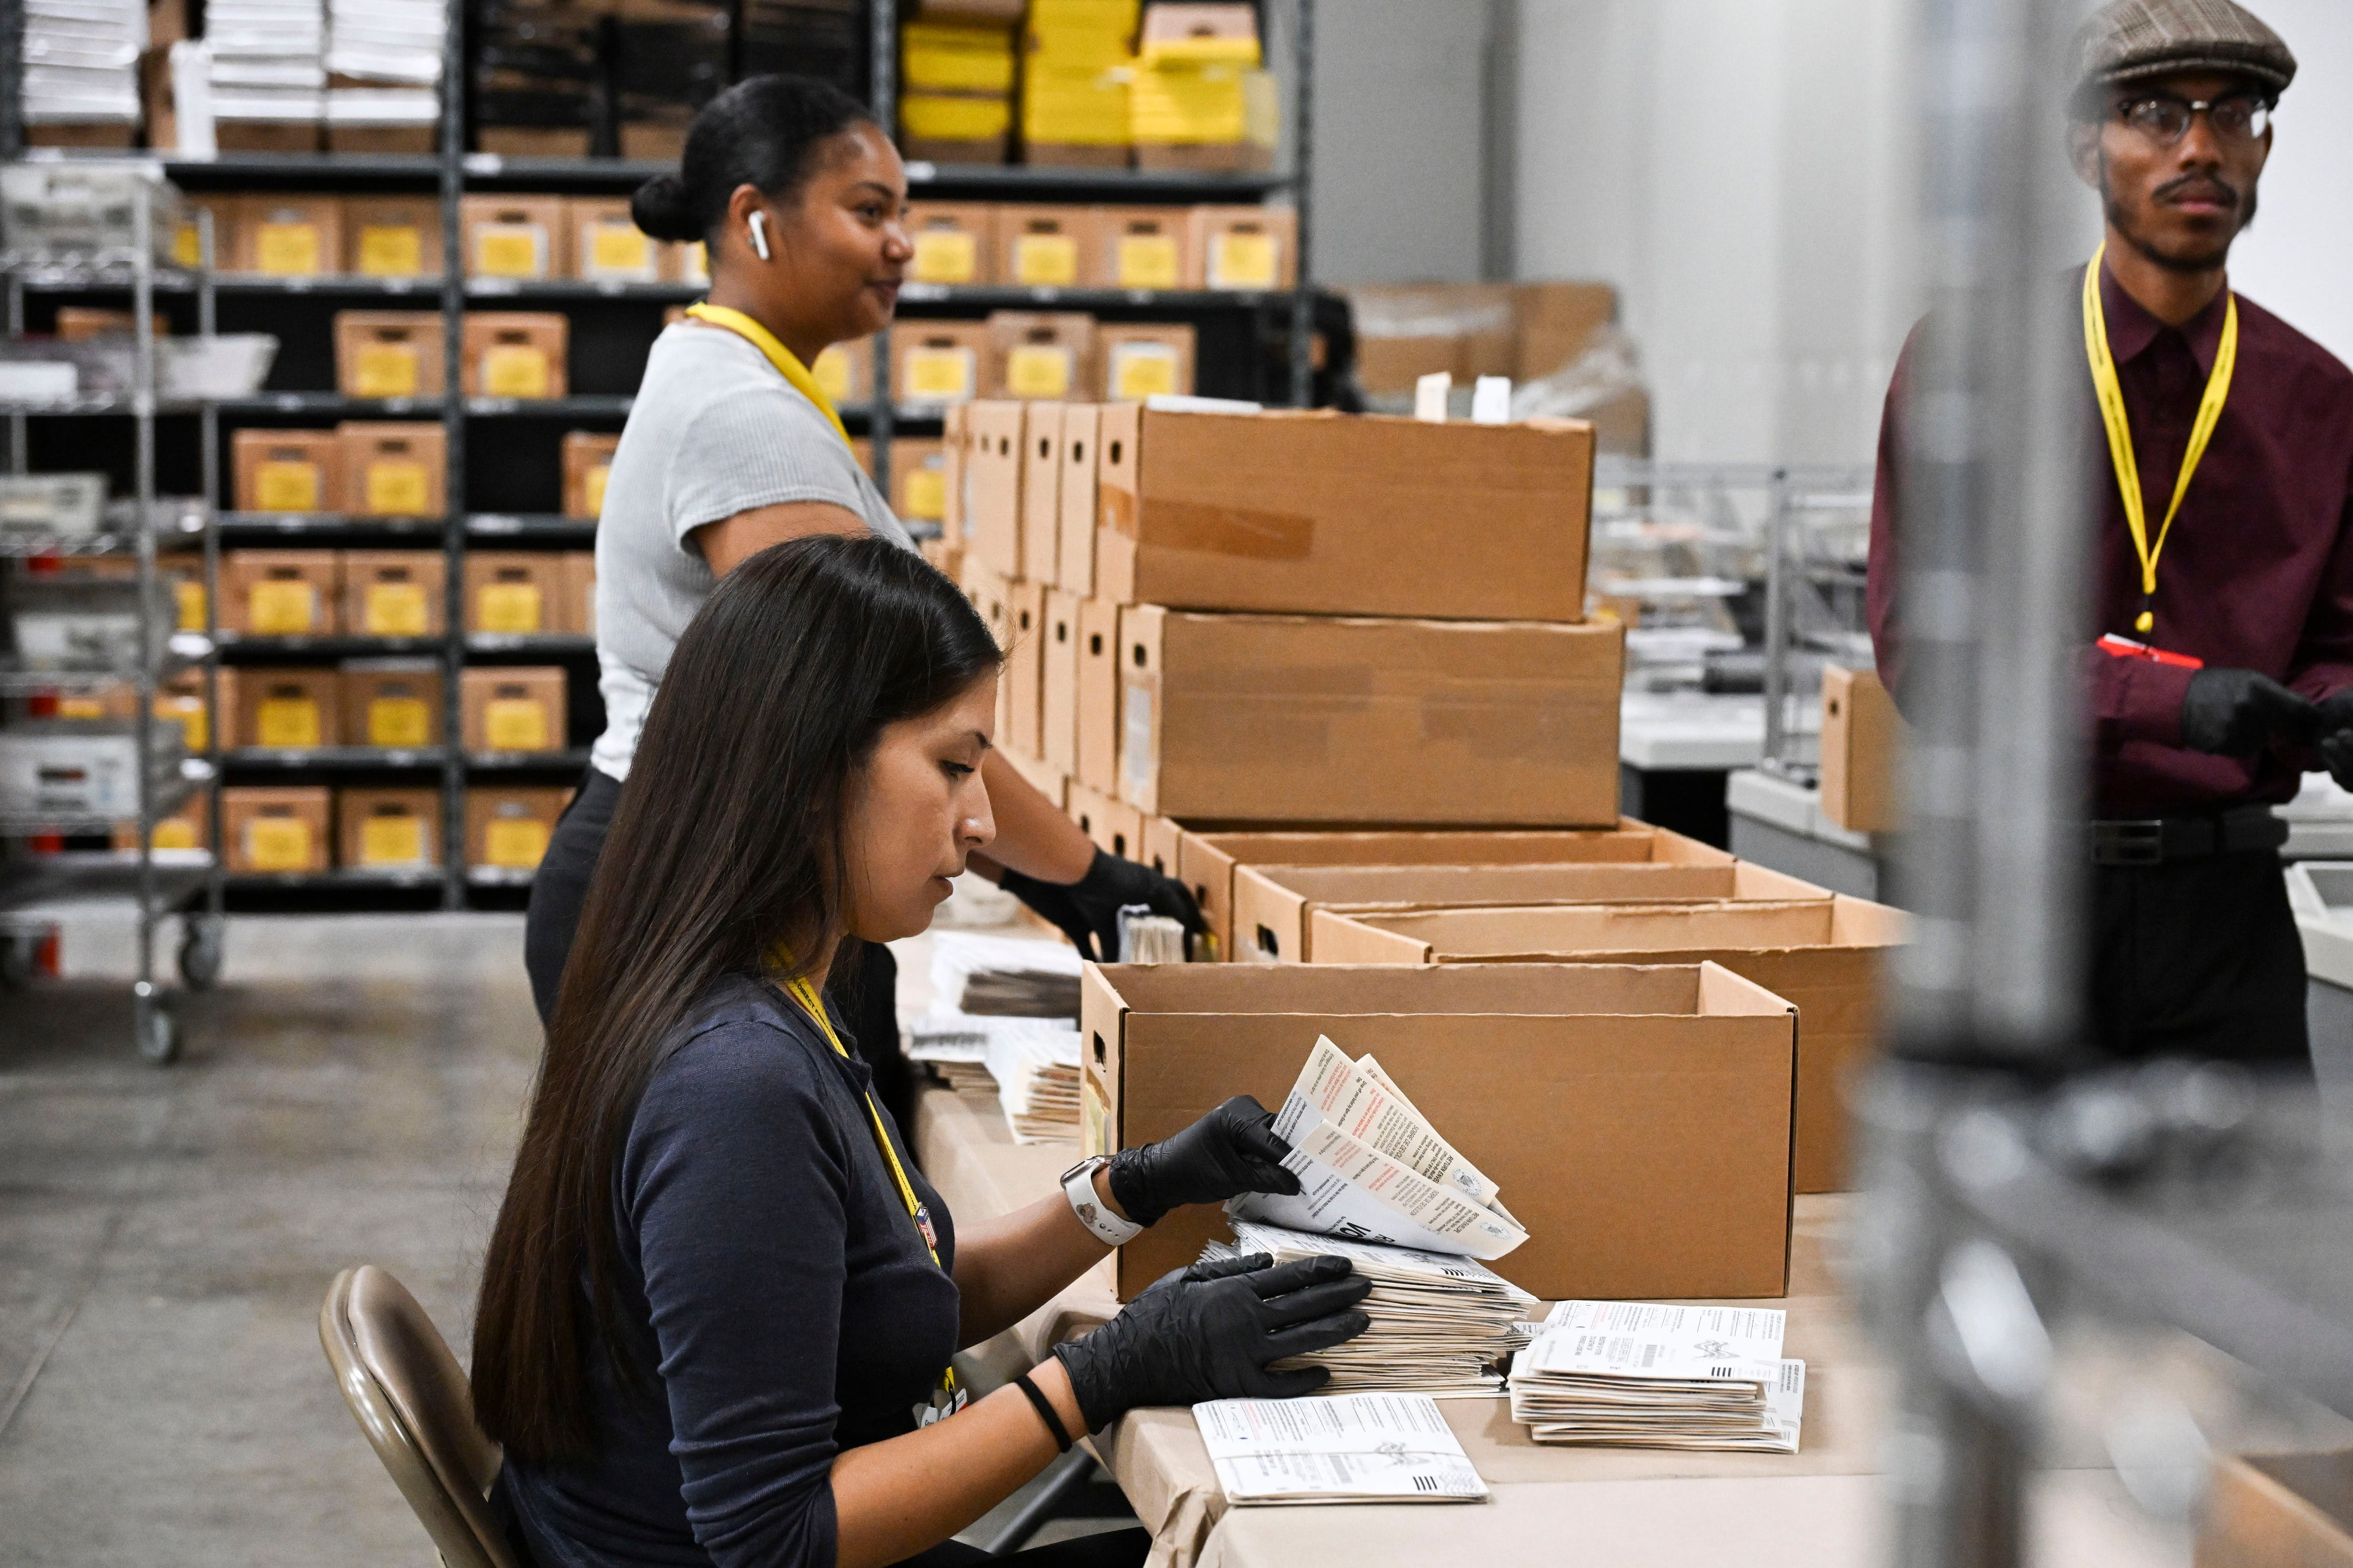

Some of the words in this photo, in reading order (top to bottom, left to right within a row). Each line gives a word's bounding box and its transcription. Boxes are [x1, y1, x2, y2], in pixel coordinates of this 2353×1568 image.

[796, 983, 815, 1009] DIRECT
[1406, 1124, 1419, 1141] SOBRE
[1402, 1138, 1411, 1147] DE
[1419, 1134, 1429, 1146] election
[1425, 1137, 1434, 1149] Voting
[1434, 1146, 1443, 1157] opened
[1439, 1150, 1448, 1162] Official
[1439, 1155, 1454, 1173] RETURN
[1426, 1189, 1439, 1201] SOBRE
[1465, 1210, 1479, 1224] RETURN
[1337, 1222, 1371, 1237] VO
[1452, 1219, 1469, 1235] ENVELOPE
